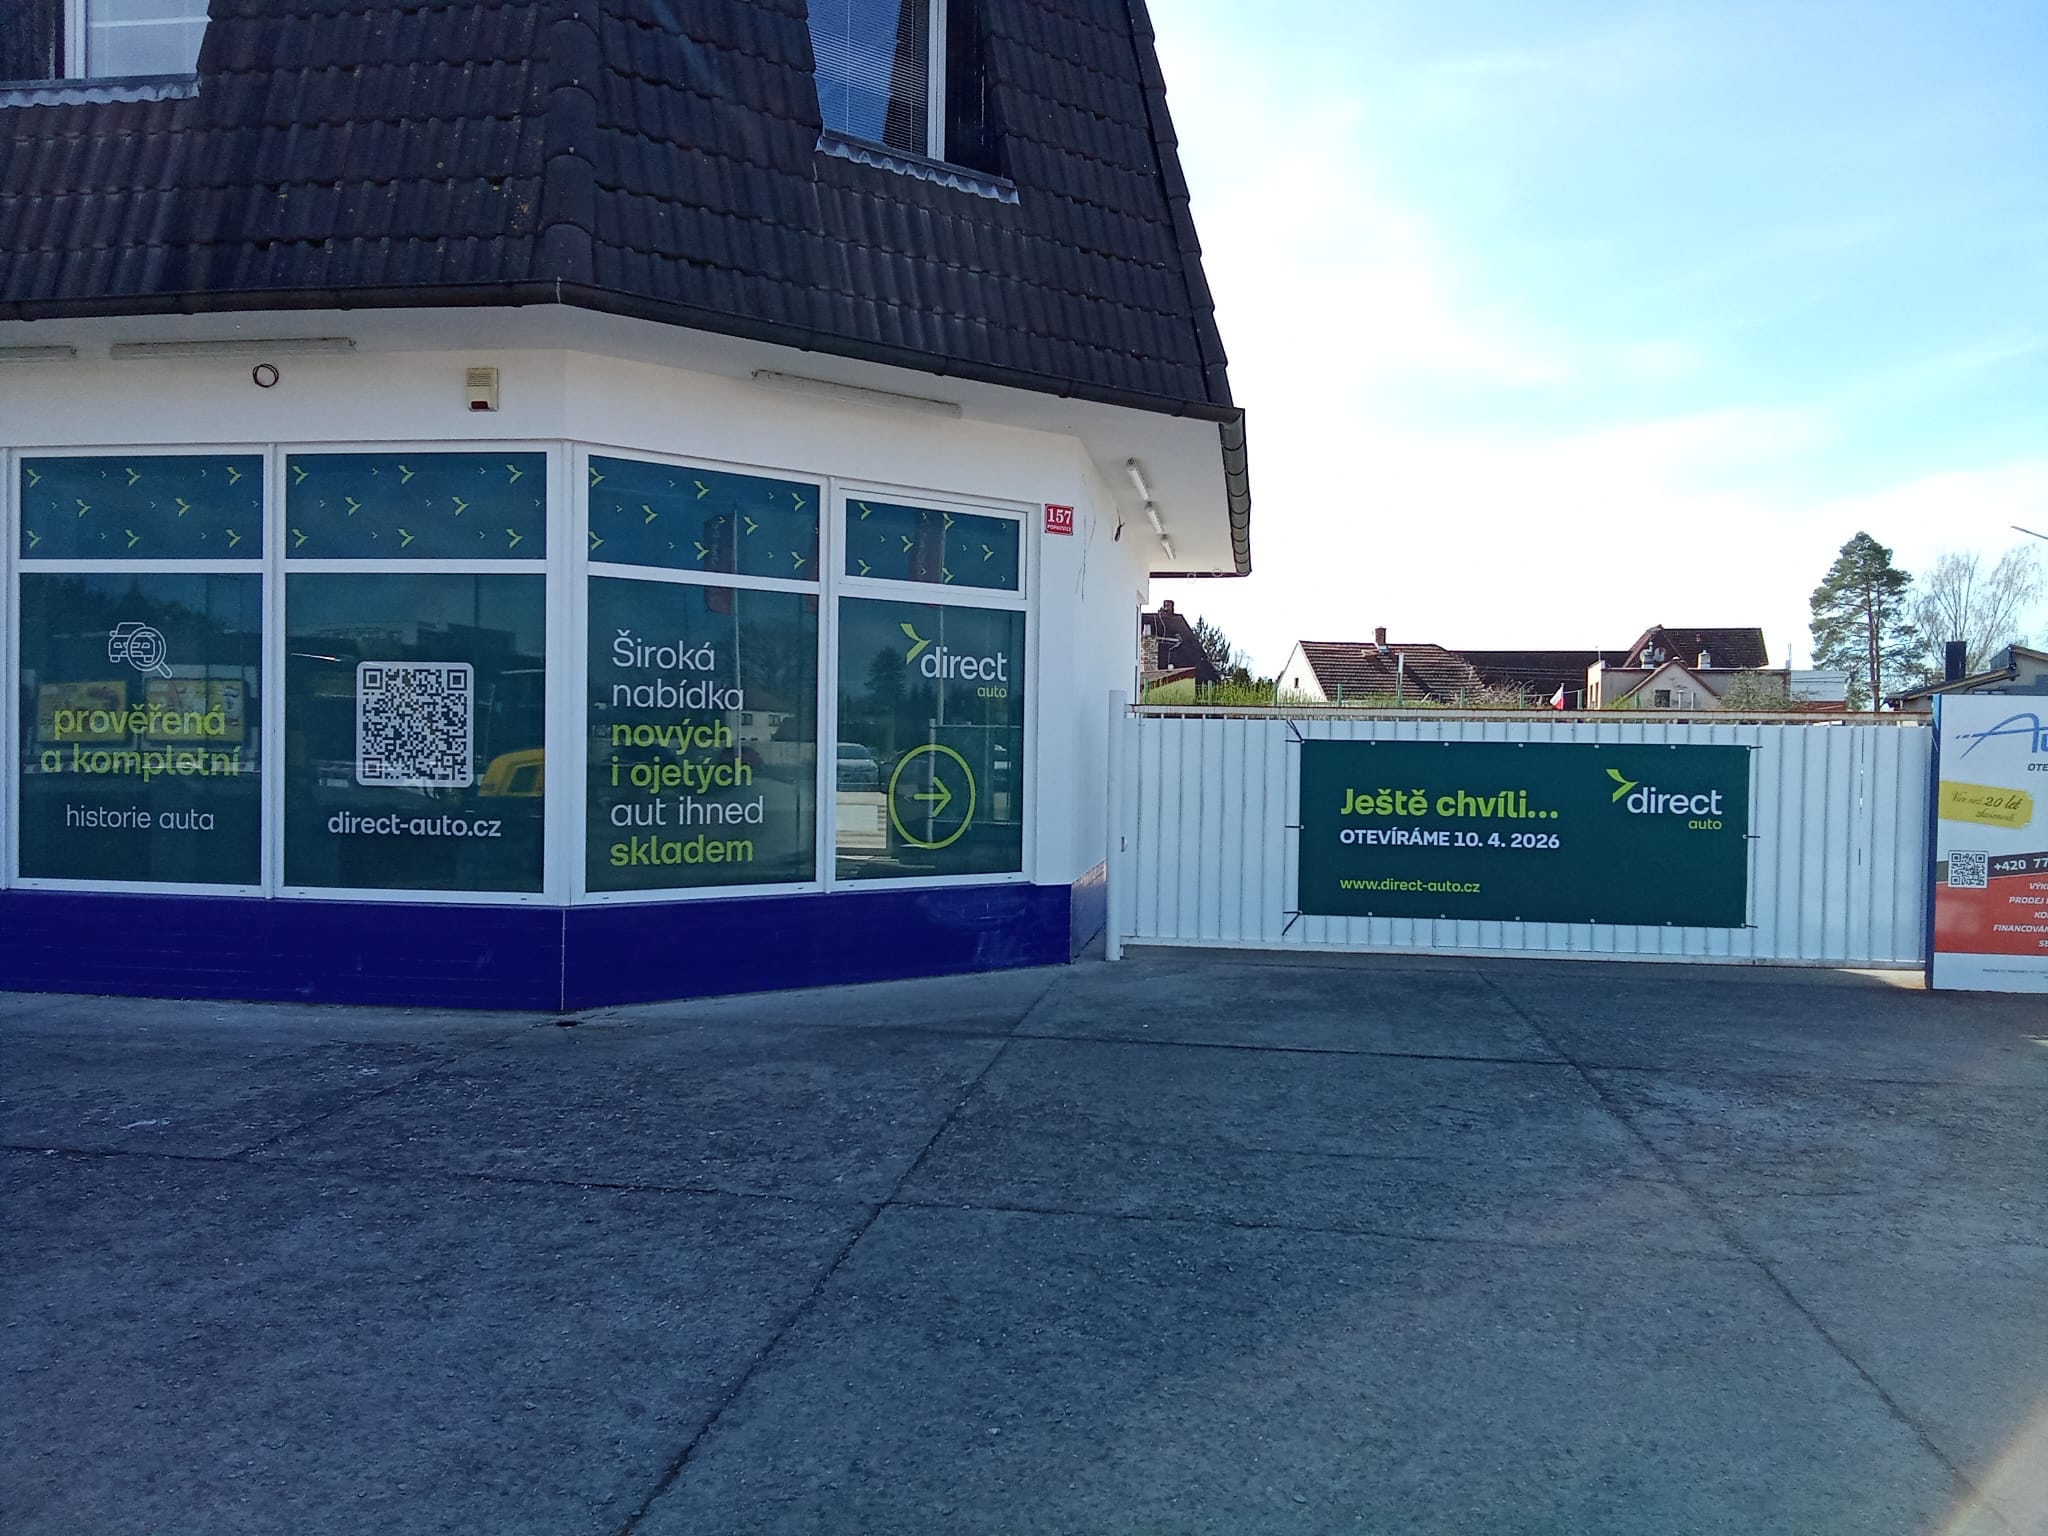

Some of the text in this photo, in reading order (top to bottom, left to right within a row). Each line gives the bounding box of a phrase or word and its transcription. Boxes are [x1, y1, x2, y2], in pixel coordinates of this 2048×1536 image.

[1048, 508, 1072, 524] 157
[613, 629, 716, 671] Široká
[920, 646, 1007, 682] direct
[612, 678, 744, 711] nabídka
[977, 684, 1007, 698] auto
[54, 704, 226, 741] prověřená
[612, 718, 732, 755] nových
[41, 742, 240, 782] a kompletní
[611, 756, 753, 795] i ojetých
[611, 795, 764, 827] aut ihned
[1340, 787, 1559, 819] Ještě chvíli...
[1627, 786, 1723, 815] direct
[1983, 796, 2003, 808] 20
[66, 804, 215, 831] historie auta
[327, 811, 502, 838] direct-auto.cz
[1688, 818, 1723, 830] auto
[611, 834, 753, 867] skladem
[1339, 827, 1561, 849] OTEVÍRÁME 10. 4. 2026
[1993, 859, 2027, 871] +420
[1340, 877, 1481, 893] www.direct-auto.cz
[2009, 896, 2045, 905] PRODEJ
